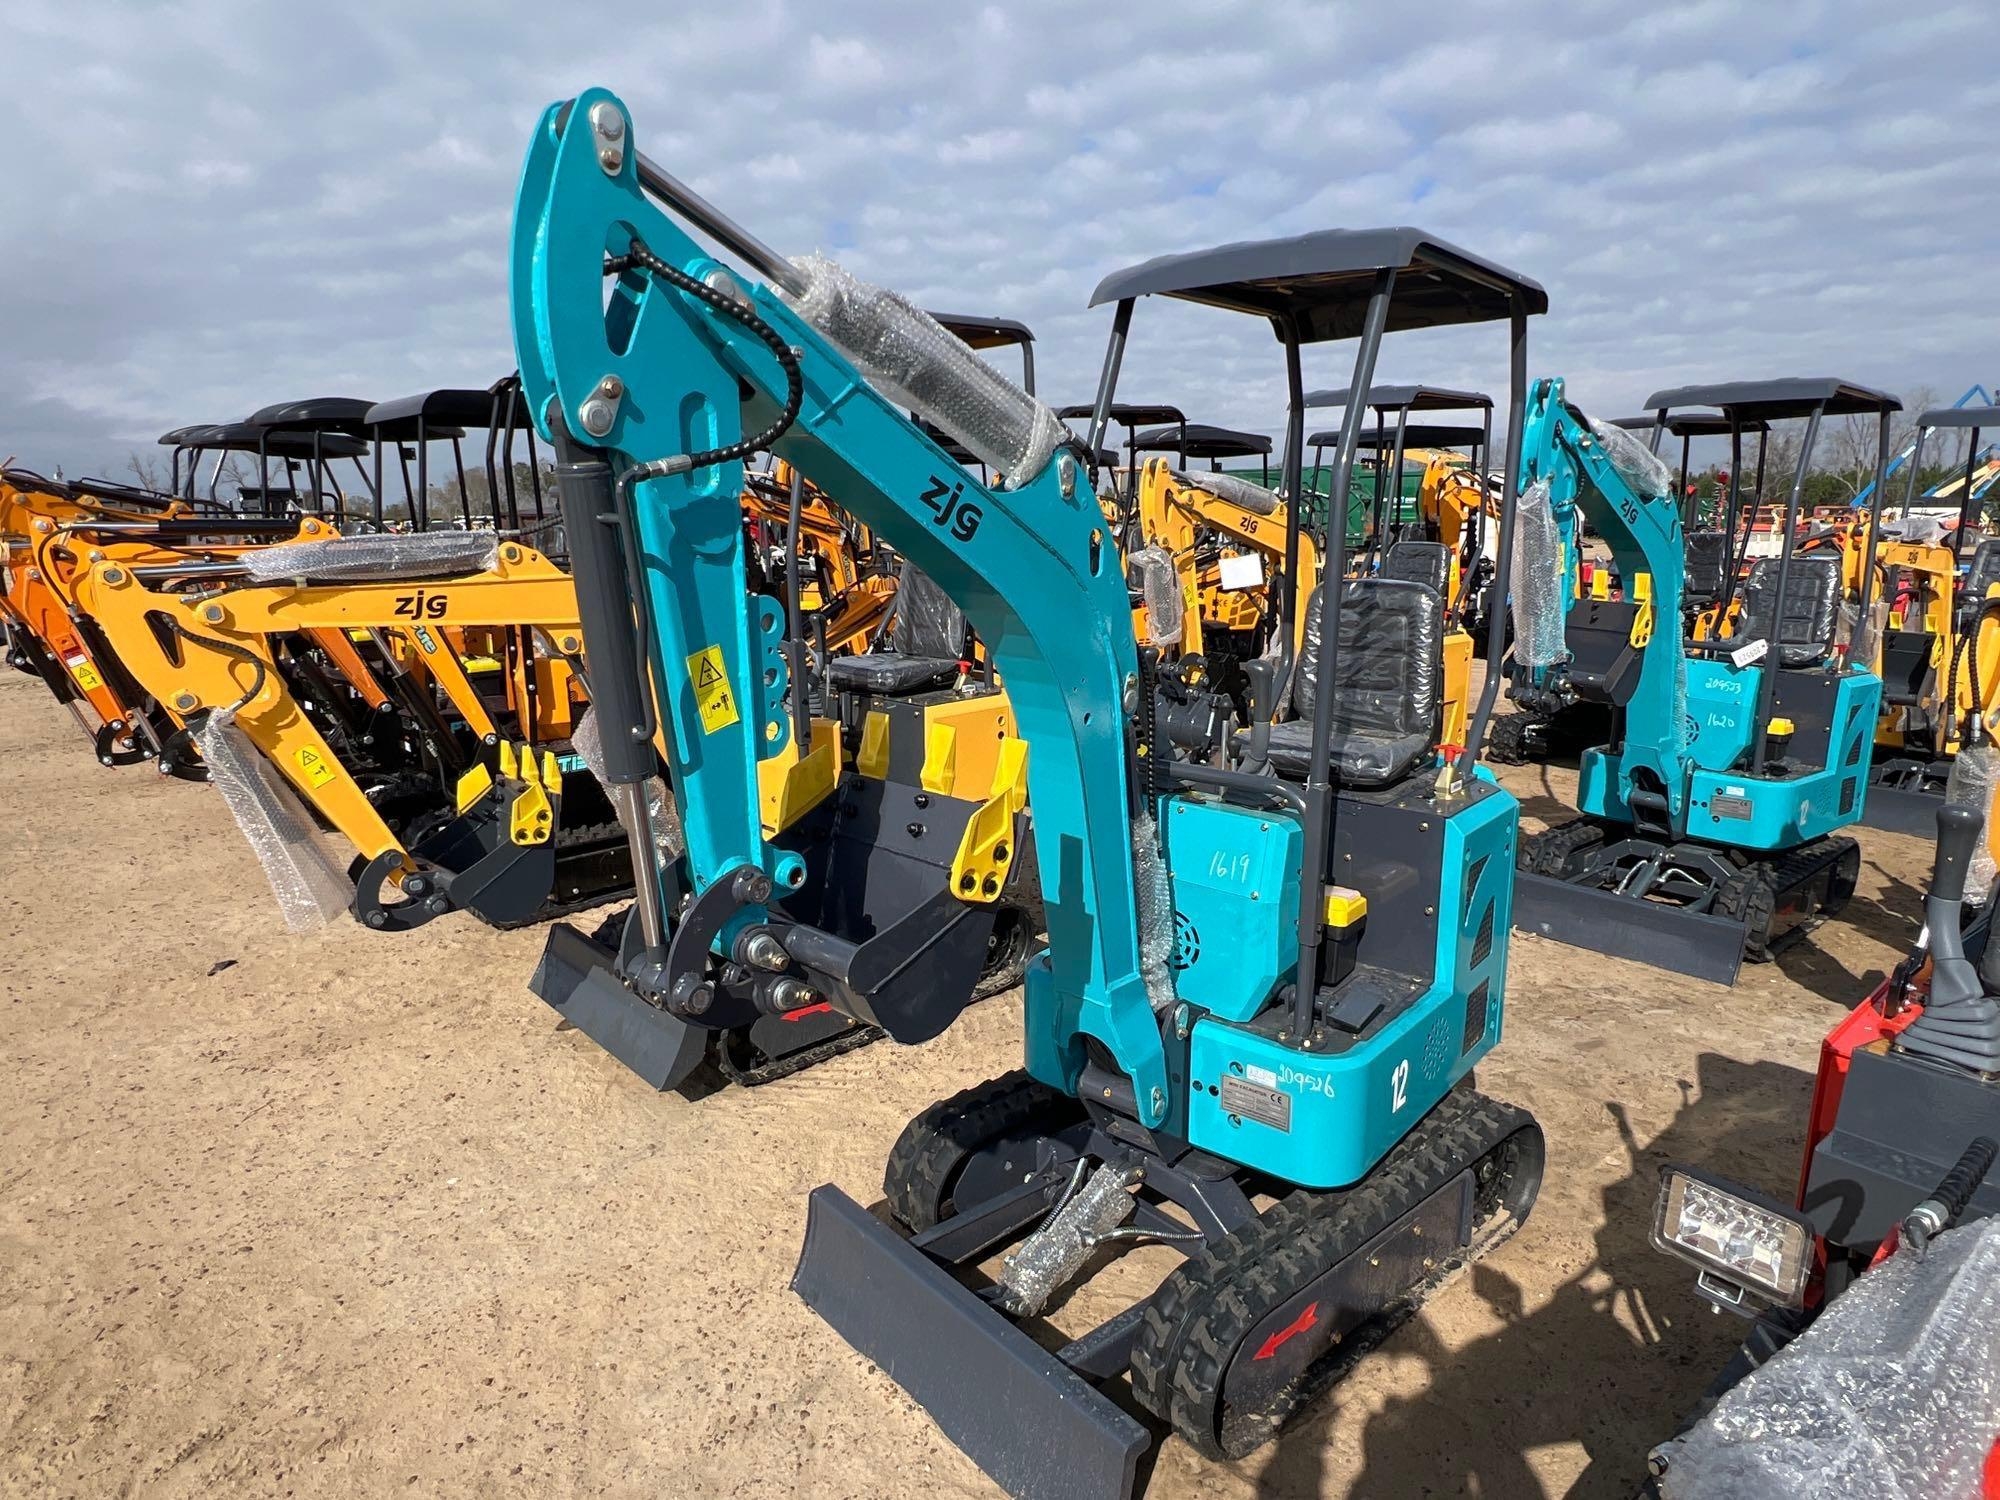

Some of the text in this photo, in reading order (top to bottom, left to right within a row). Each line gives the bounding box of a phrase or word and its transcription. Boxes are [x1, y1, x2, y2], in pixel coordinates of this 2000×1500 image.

[919, 474, 984, 543] zjg
[1620, 498, 1639, 525] zjg
[1240, 515, 1259, 534] zjg
[394, 590, 448, 621] zjg
[1707, 713, 1735, 728] 1620
[1208, 850, 1250, 884] 1619
[1391, 1059, 1409, 1114] 12
